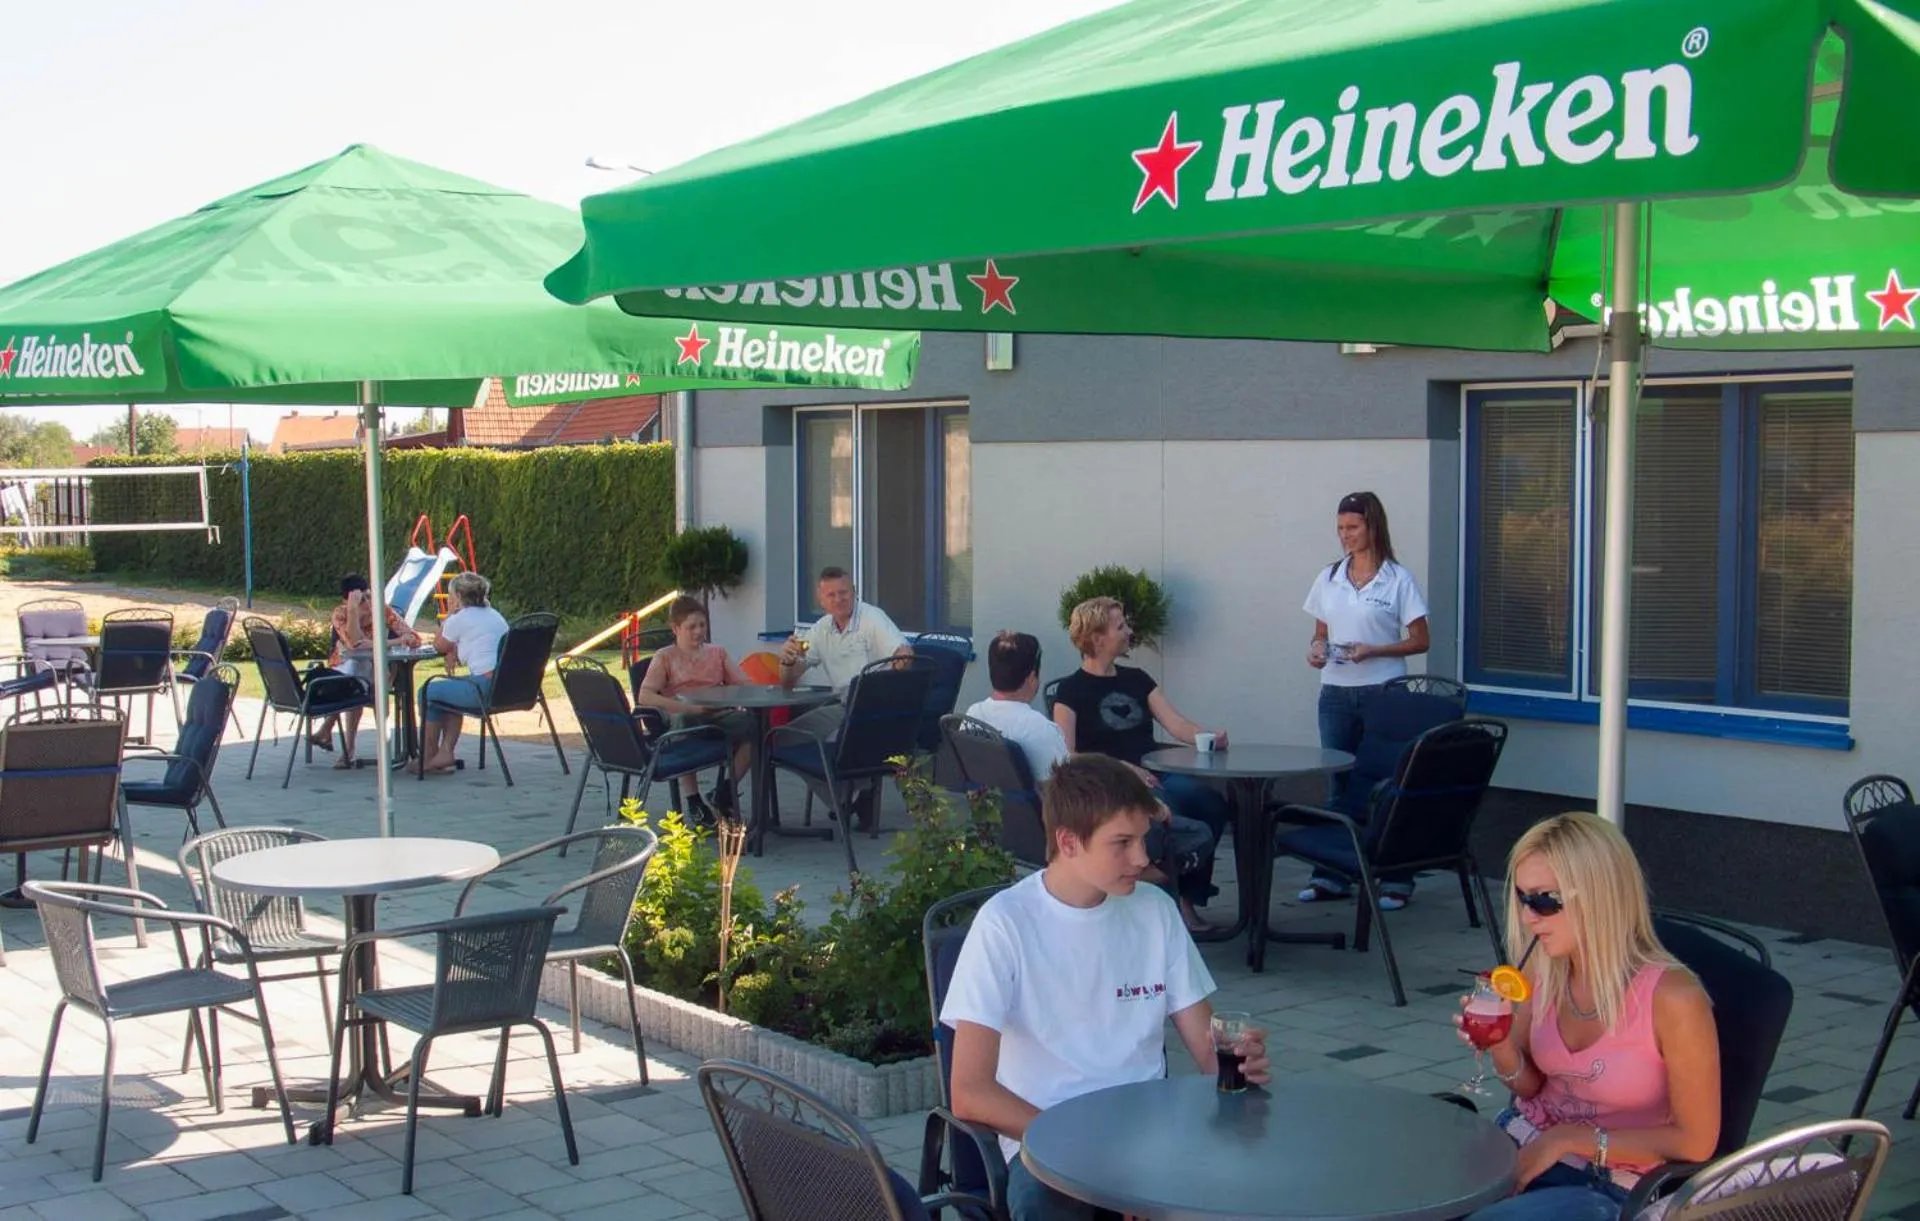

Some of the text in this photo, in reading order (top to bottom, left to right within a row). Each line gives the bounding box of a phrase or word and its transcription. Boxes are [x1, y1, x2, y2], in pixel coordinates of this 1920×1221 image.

[1206, 61, 1699, 201] Heineken
[15, 332, 144, 378] Heineken
[714, 327, 886, 377] Heineken
